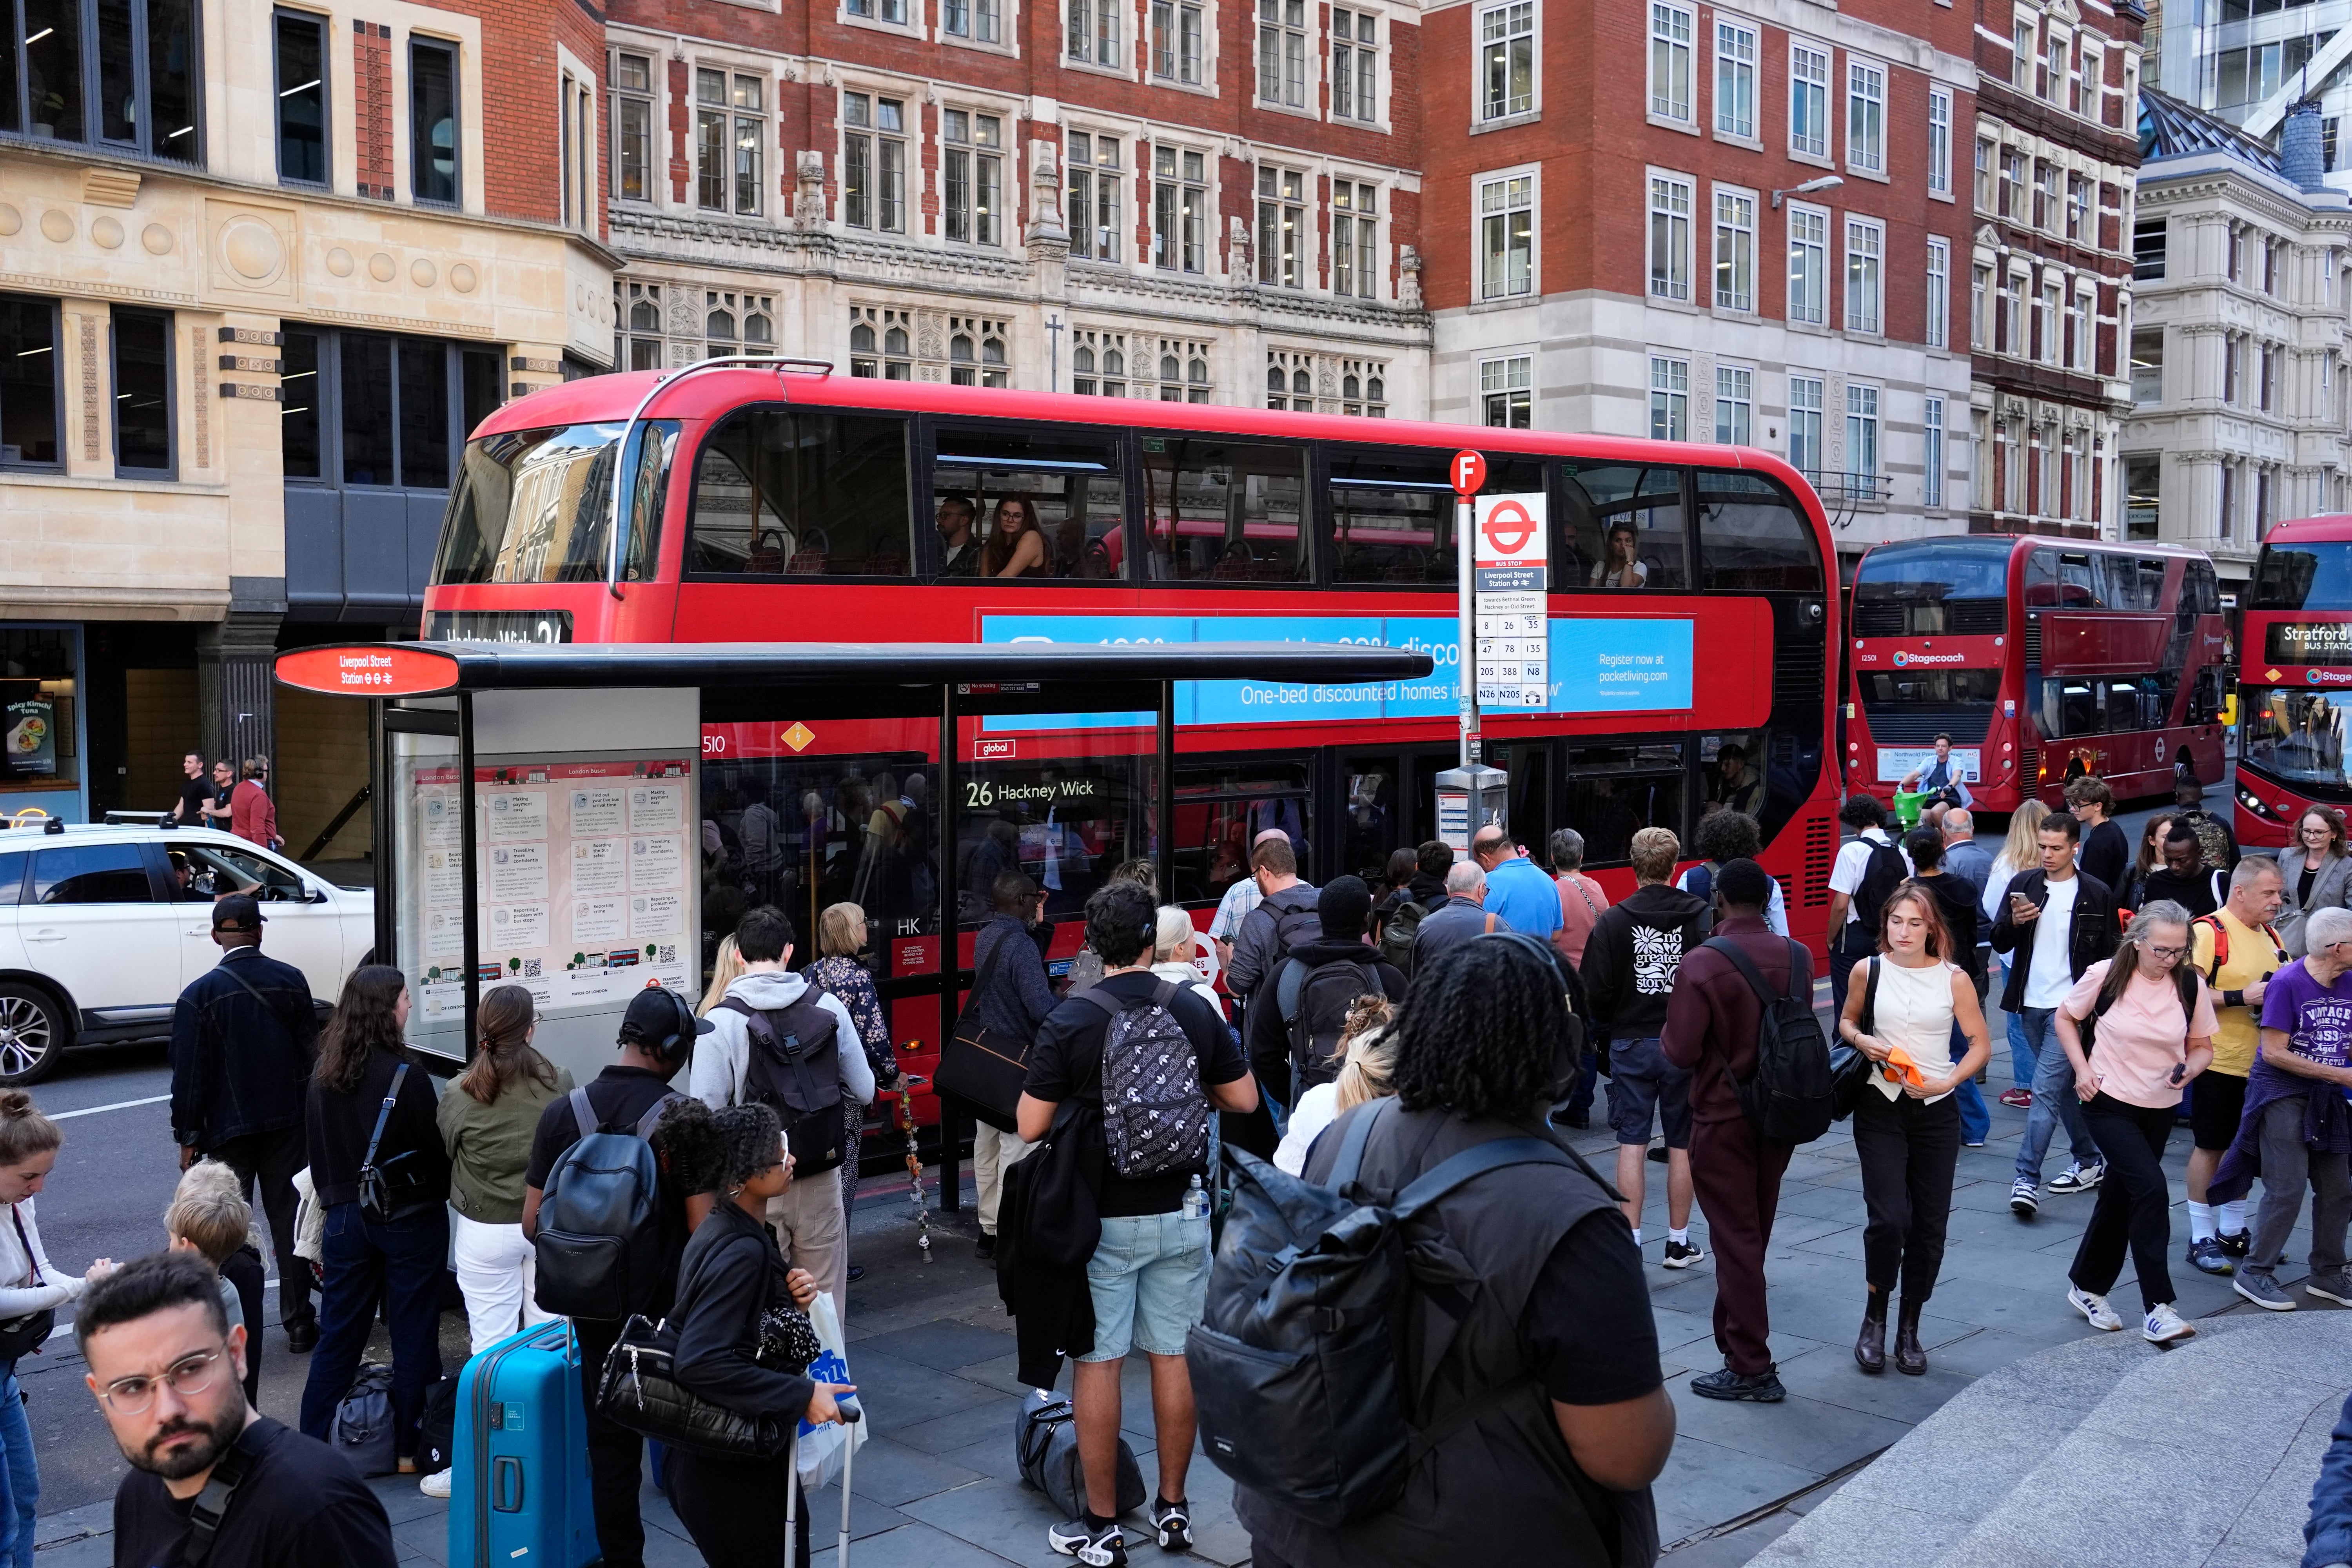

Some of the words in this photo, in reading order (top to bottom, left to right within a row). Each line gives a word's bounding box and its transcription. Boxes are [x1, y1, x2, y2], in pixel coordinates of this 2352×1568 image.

[1460, 456, 1475, 488] F
[1485, 572, 1512, 580] Liverpool
[2285, 626, 2347, 641] Stratford
[340, 655, 369, 670] Liverpool
[370, 655, 392, 667] Street
[1600, 654, 1634, 667] Register
[1636, 655, 1653, 664] now
[1655, 655, 1664, 664] at
[1908, 653, 1964, 664] Stagecoach
[341, 671, 363, 684] Station
[1599, 670, 1668, 684] pocketliving.com
[1241, 685, 1308, 704] One-bed
[1313, 683, 1396, 702] discounted
[1401, 684, 1448, 701] homes
[7, 702, 25, 712] Spicy
[702, 736, 725, 753] 510
[983, 742, 1007, 756] global
[967, 782, 993, 807] 26
[998, 784, 1056, 801] Hackney
[1061, 780, 1094, 796] Wick
[898, 918, 920, 935] HK
[1664, 931, 1682, 943] no
[1192, 960, 1205, 969] SES
[1636, 953, 1682, 967] greater
[1636, 976, 1669, 991] story
[2306, 1006, 2351, 1020] VINTAGE
[1139, 1042, 1164, 1068] adidas
[2311, 1043, 2337, 1054] Aged
[2294, 1051, 2346, 1066] PERFECTLY
[1154, 1107, 1181, 1132] adidas
[1180, 1108, 1205, 1143] adidas
[1142, 1128, 1176, 1154] adidas
[1132, 1151, 1169, 1171] adidas
